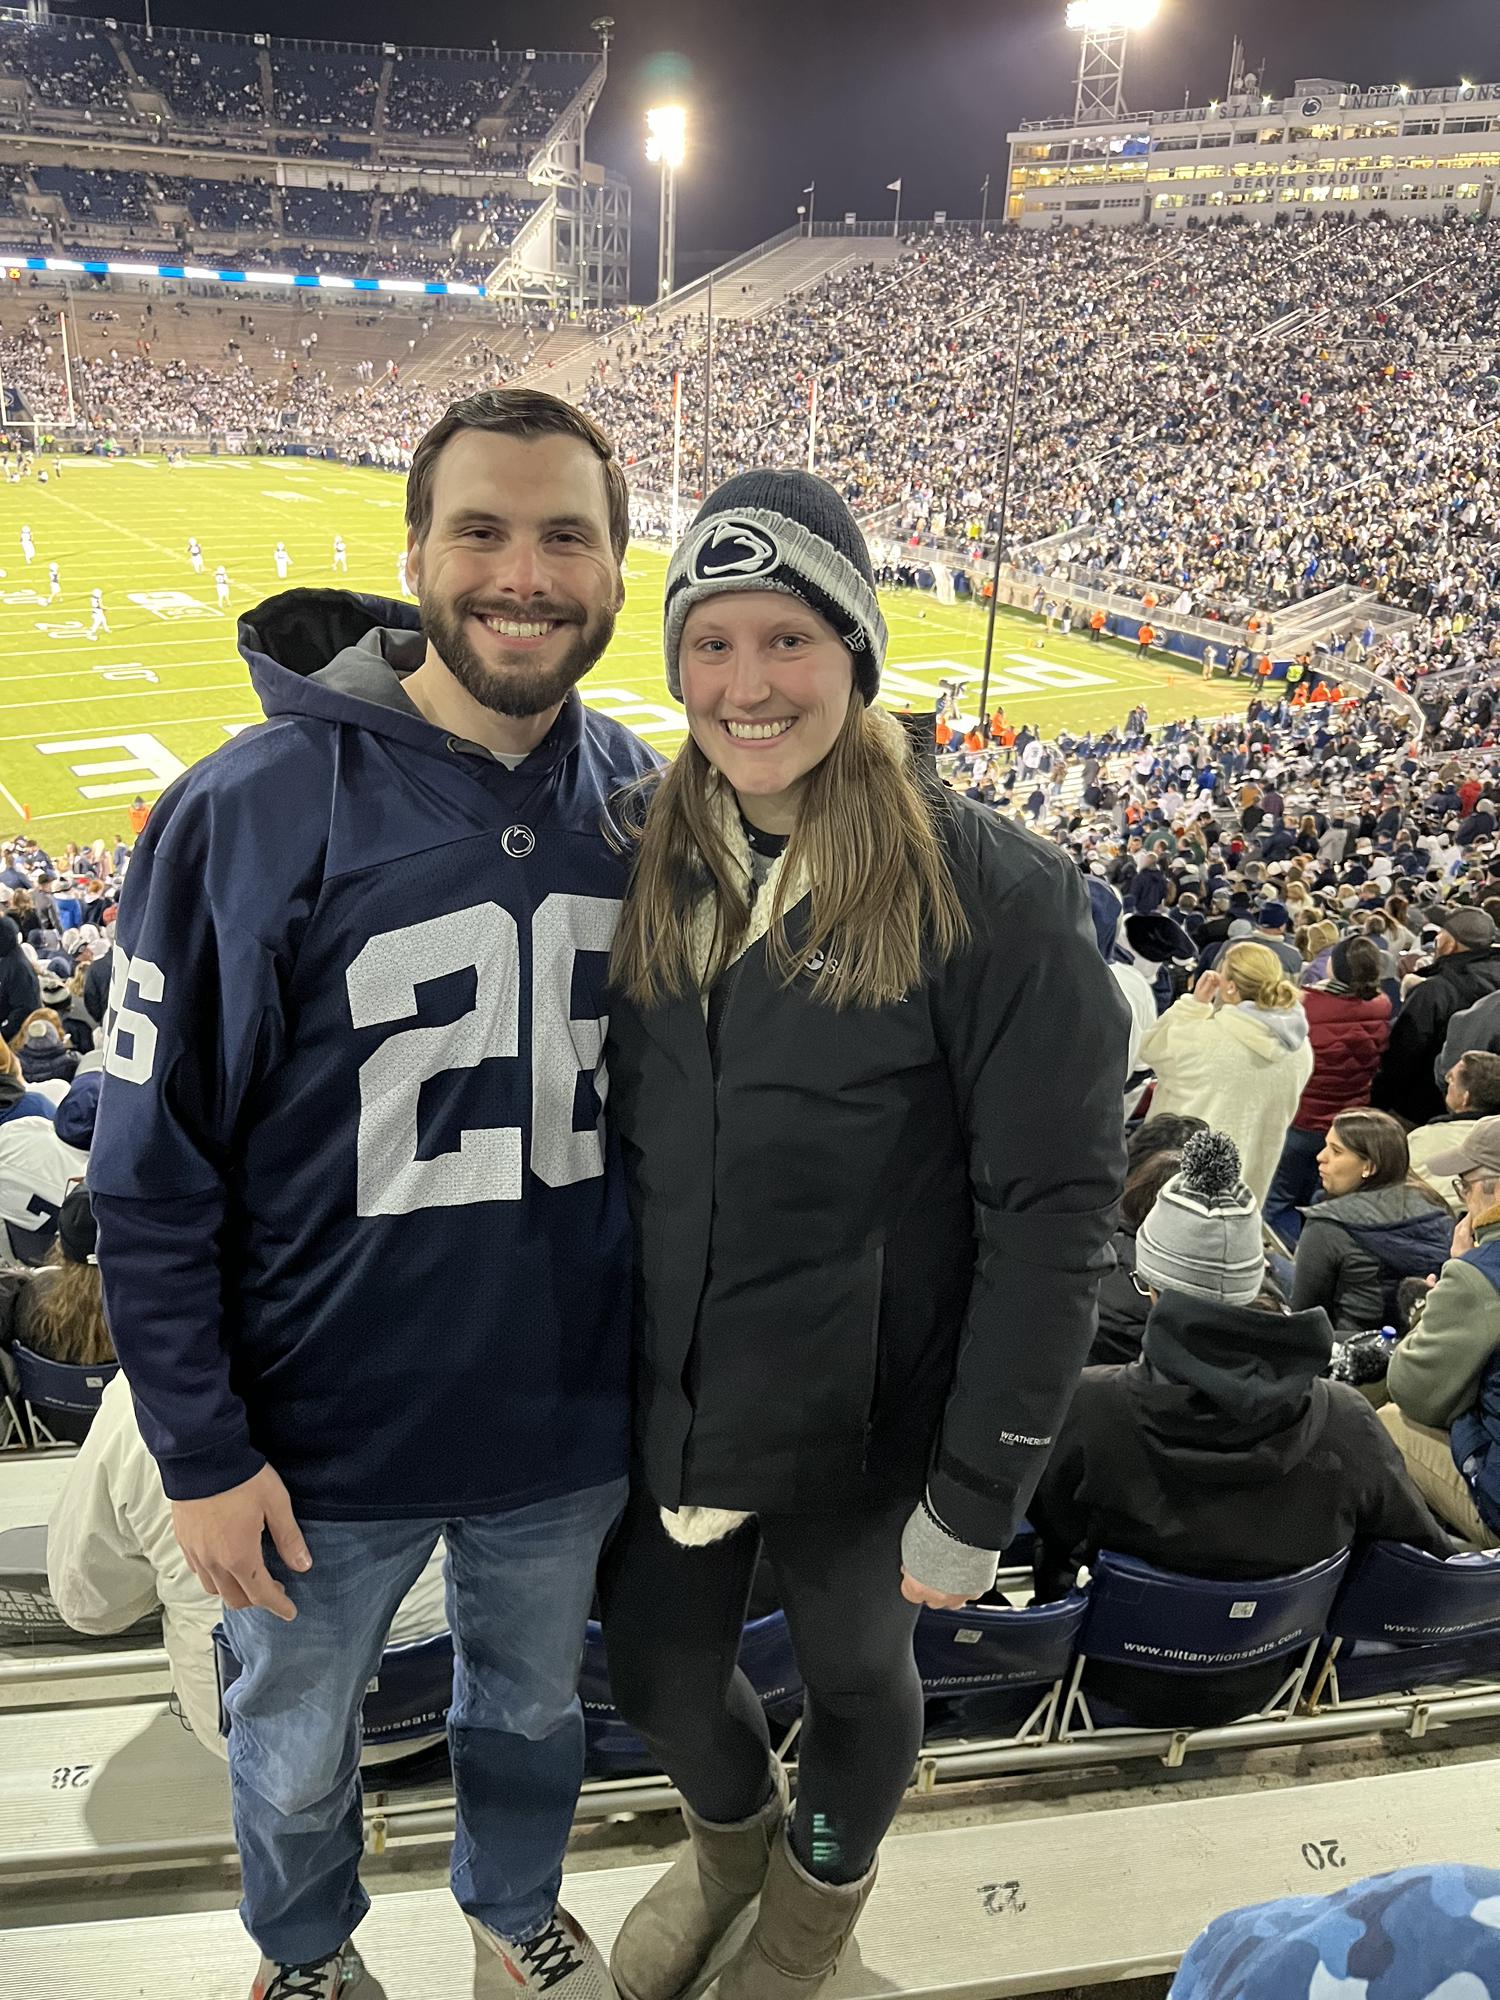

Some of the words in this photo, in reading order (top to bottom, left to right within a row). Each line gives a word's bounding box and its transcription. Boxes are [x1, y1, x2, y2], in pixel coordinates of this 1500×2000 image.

[1160, 111, 1207, 125] PENN
[1219, 102, 1278, 119] STATE
[1352, 90, 1432, 110] NITTANY
[1442, 85, 1500, 103] LIONS
[1233, 175, 1297, 189] BEAVER
[1306, 172, 1384, 187] STADIUM
[1123, 1628, 1303, 1663] www.nittanylionseats.com
[51, 1765, 93, 1790] 28
[1300, 1839, 1347, 1871] 20
[976, 1880, 1027, 1916] 22
